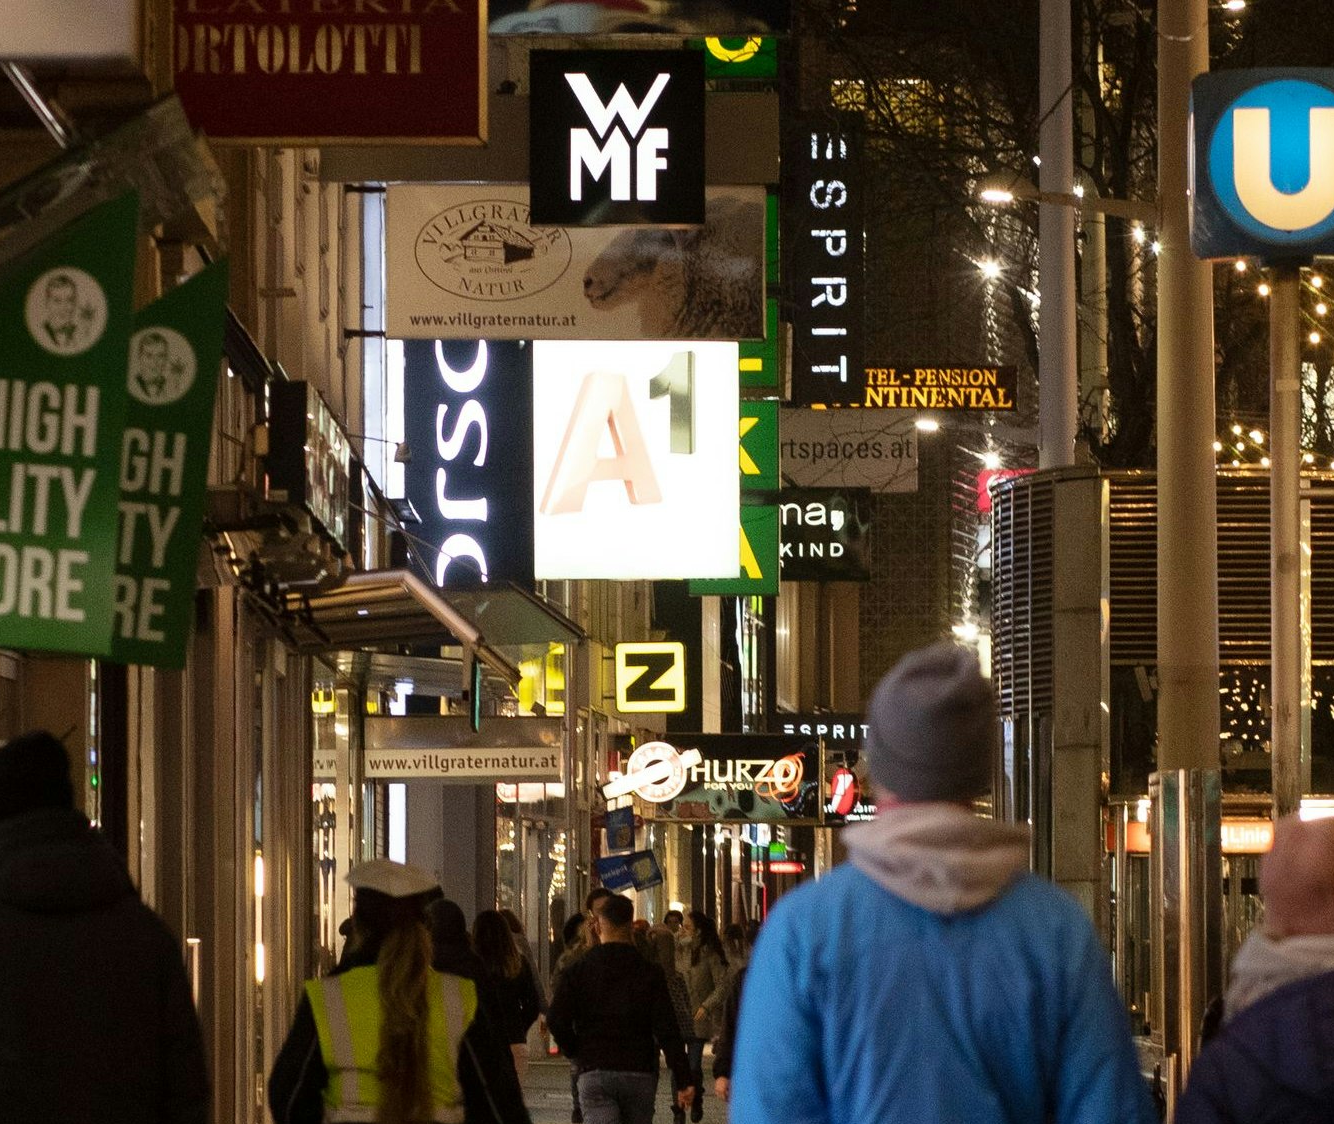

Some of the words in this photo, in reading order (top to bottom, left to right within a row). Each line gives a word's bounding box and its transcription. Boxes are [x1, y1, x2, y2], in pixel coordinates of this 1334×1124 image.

[810, 131, 848, 383] ESPRIT
[459, 276, 525, 297] NATUR
[409, 311, 577, 330] www.villgraternatur.at
[539, 350, 697, 516] A1
[119, 427, 188, 496] GH
[779, 542, 845, 558] KIND
[624, 652, 676, 702] Z
[368, 754, 558, 776] www.villgraternatur.at
